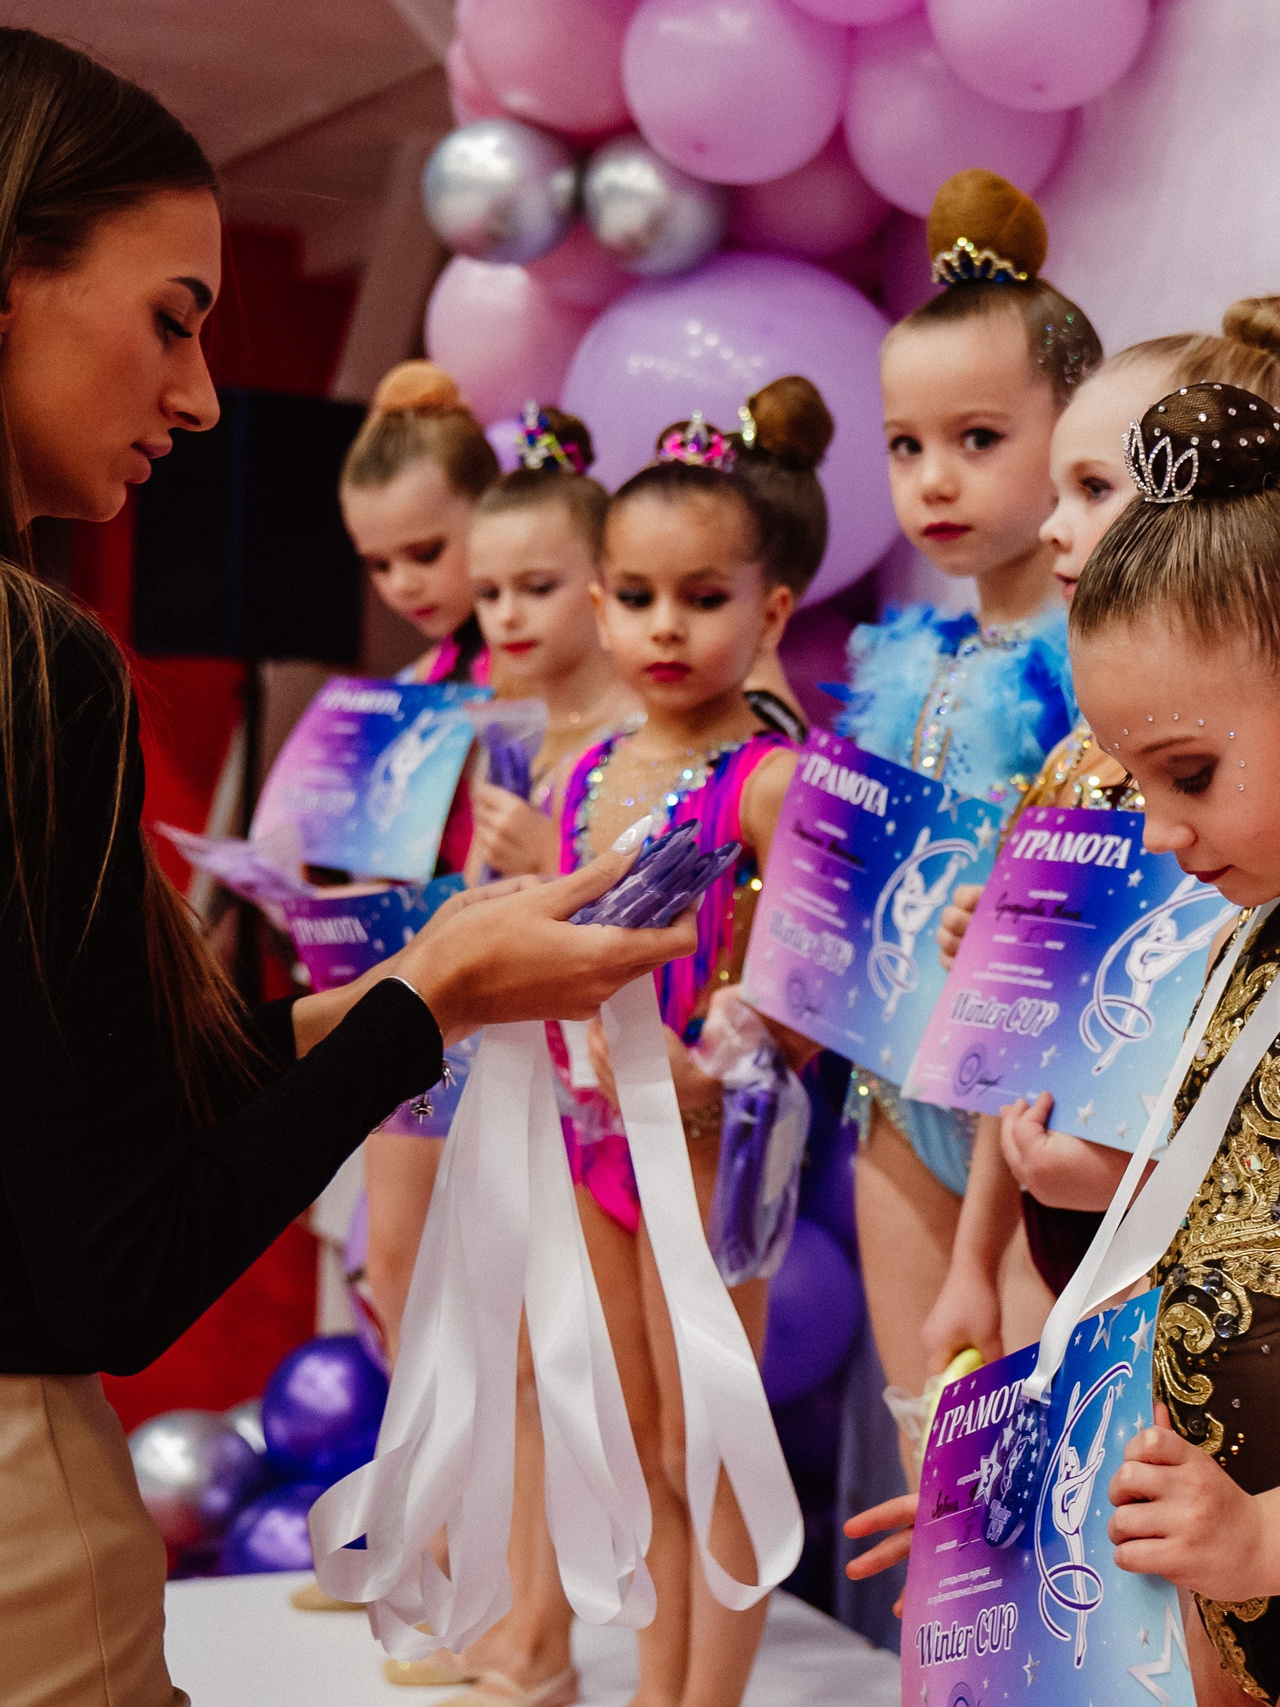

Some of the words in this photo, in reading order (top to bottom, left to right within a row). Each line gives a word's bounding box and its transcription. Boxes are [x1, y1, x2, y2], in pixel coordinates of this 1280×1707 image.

[801, 753, 889, 817] ГРАМОТА
[1013, 829, 1132, 869] ГРАМОТА
[935, 1378, 1026, 1448] ГРАМОТ
[983, 1463, 993, 1488] 3
[915, 1620, 974, 1668] Winter
[974, 1602, 1019, 1656] CUP
